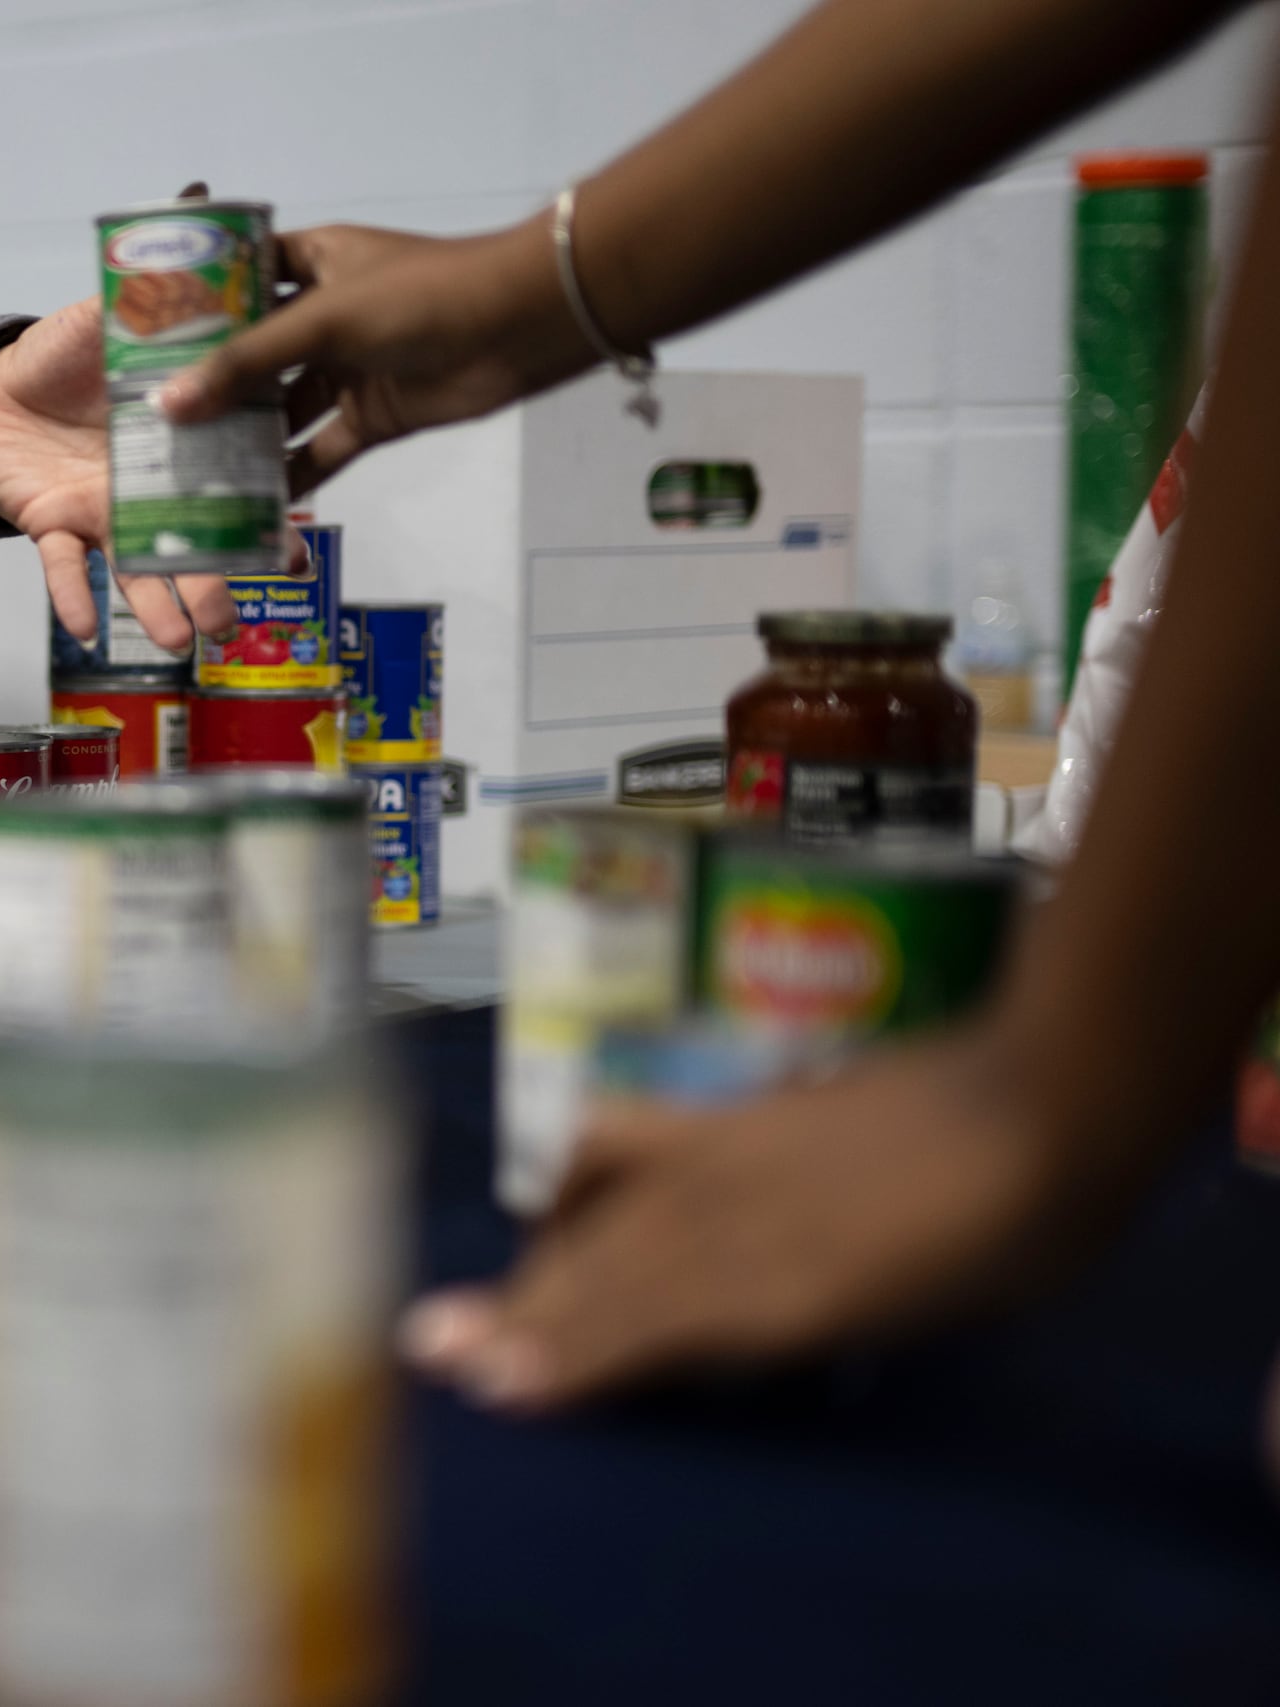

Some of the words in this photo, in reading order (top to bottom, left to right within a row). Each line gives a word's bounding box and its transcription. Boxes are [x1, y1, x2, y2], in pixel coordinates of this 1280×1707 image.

[230, 588, 264, 601] mato
[266, 586, 309, 602] Sauce
[242, 602, 260, 618] de
[263, 602, 315, 618] Tomate
